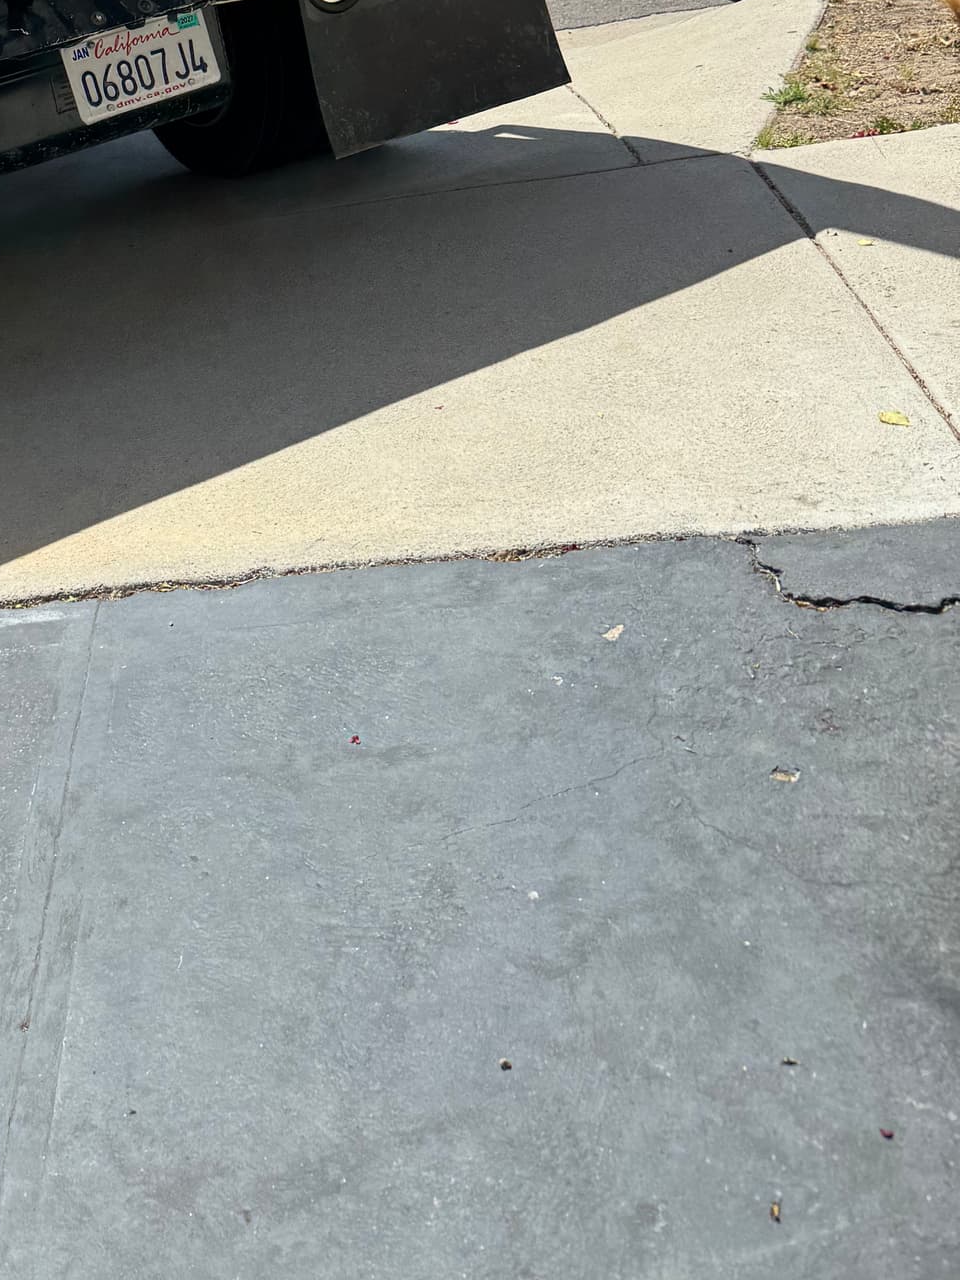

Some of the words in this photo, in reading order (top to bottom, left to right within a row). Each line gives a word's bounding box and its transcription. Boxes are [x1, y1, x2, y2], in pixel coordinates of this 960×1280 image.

[181, 15, 194, 25] 2027
[71, 47, 90, 62] JAN
[94, 25, 180, 60] California
[80, 39, 208, 108] 06807J4
[116, 82, 187, 110] dmv.ca.gov
